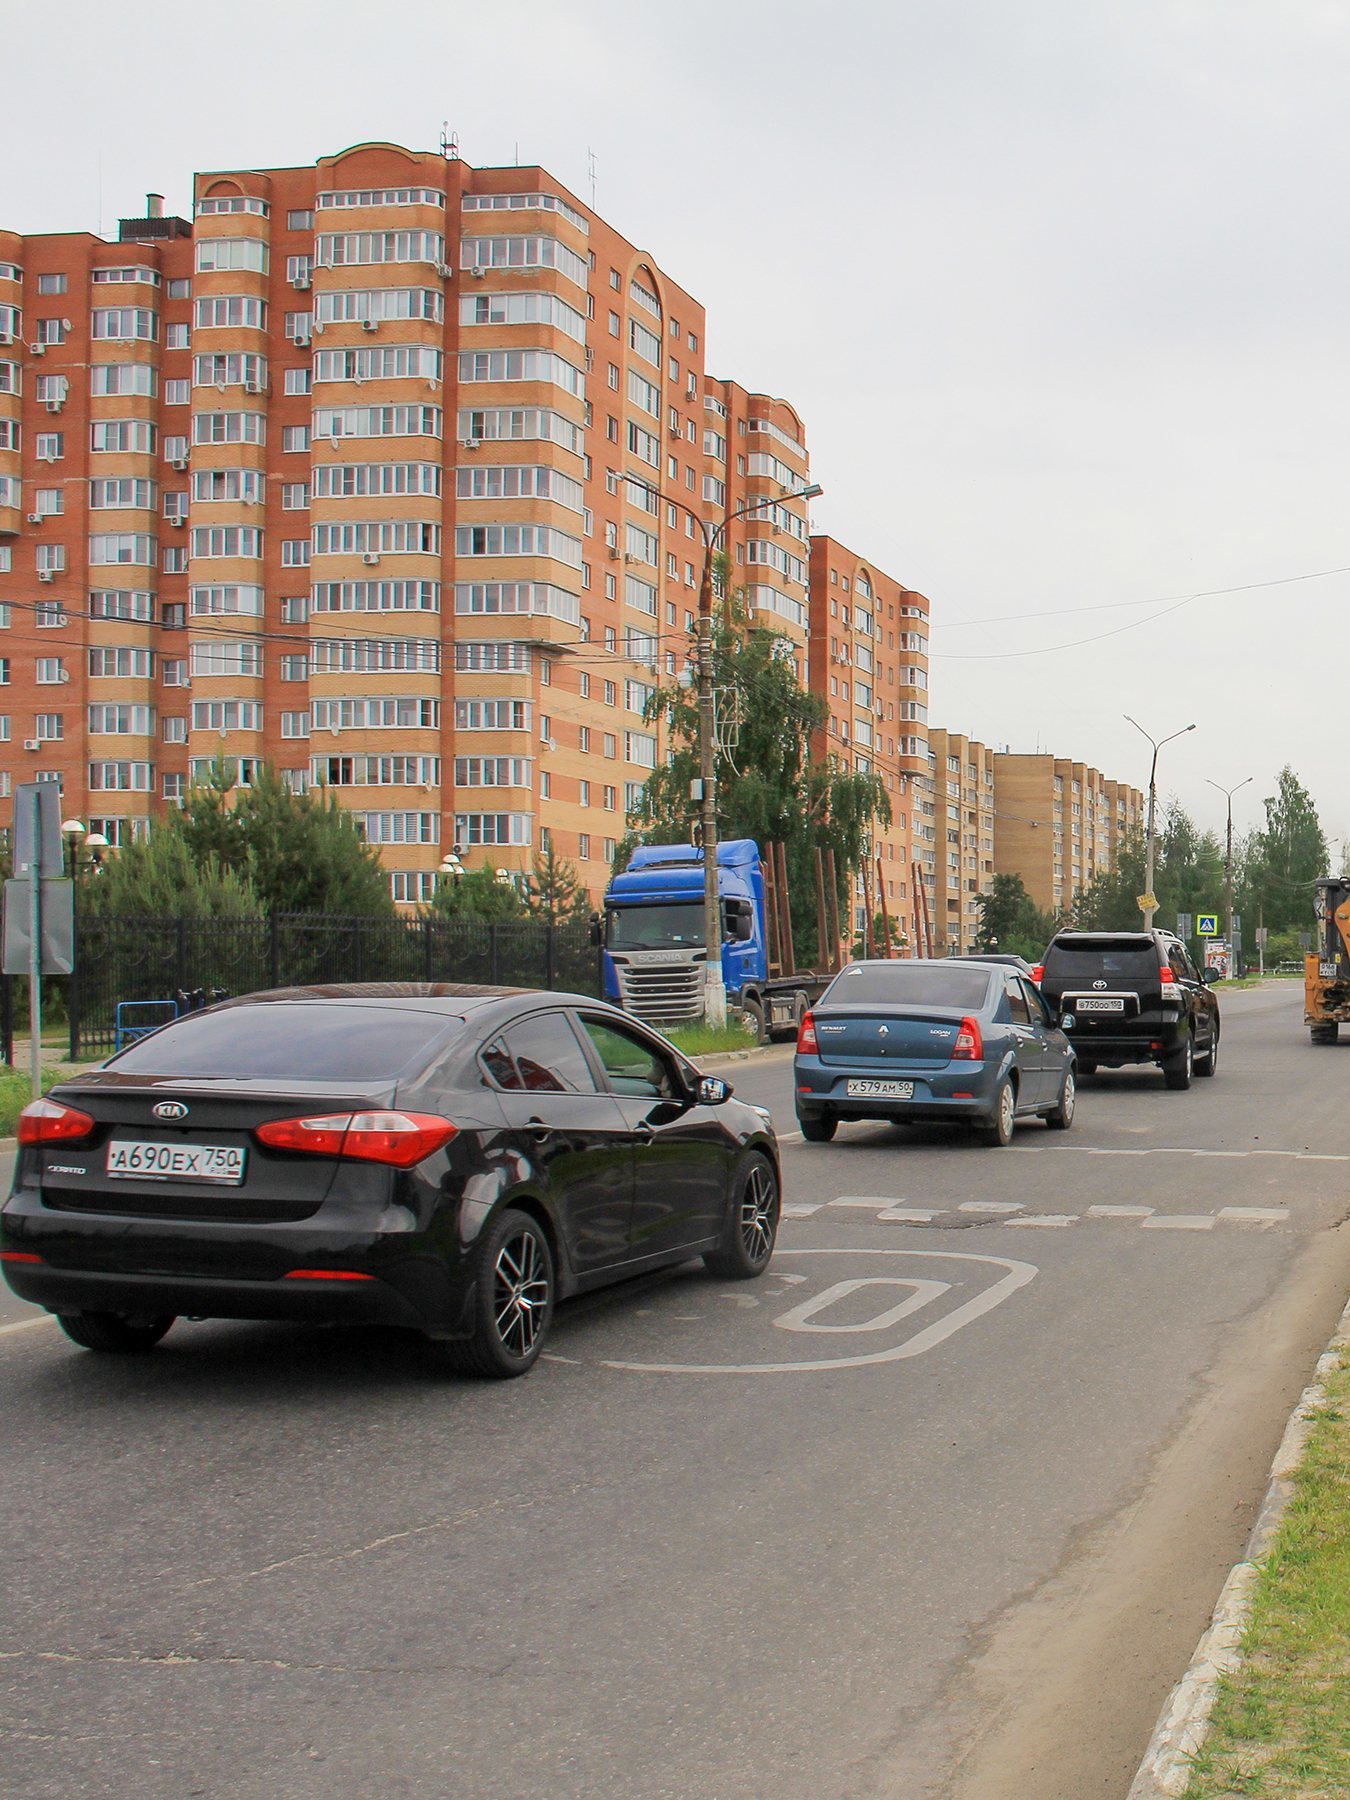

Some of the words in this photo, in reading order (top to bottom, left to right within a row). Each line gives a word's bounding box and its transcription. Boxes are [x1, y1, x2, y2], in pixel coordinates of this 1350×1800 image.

[638, 953, 683, 963] SCANIA
[157, 1105, 182, 1117] KIA
[205, 1148, 237, 1167] 750
